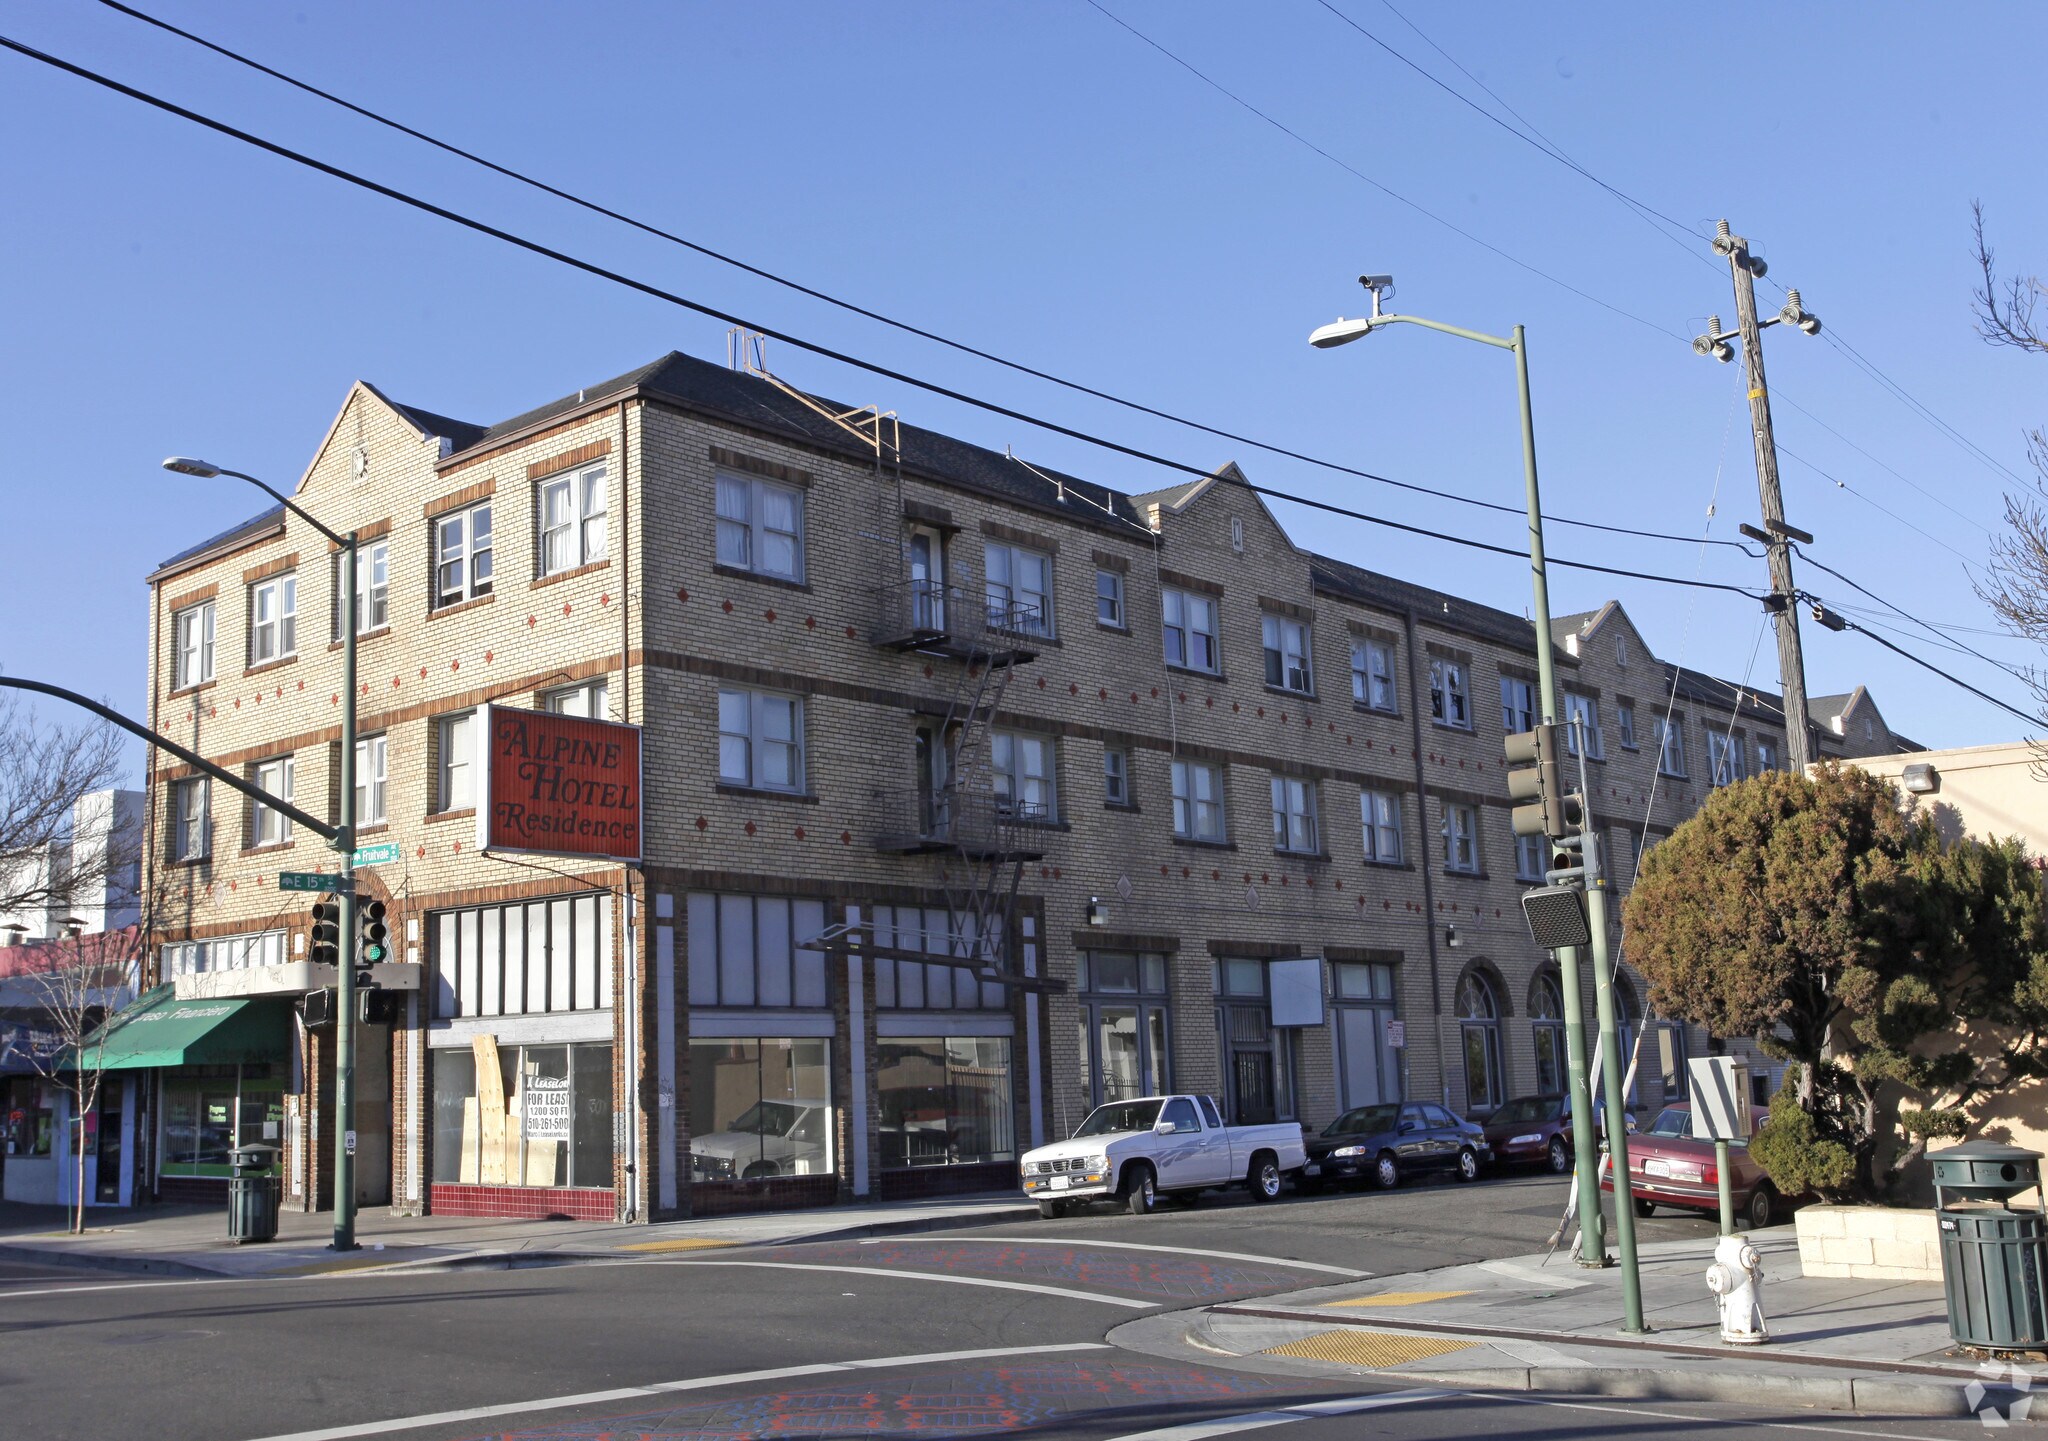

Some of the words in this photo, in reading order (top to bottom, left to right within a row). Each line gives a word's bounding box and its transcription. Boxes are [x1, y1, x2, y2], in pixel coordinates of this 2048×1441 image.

[496, 718, 621, 769] ALPINE
[518, 761, 635, 810] HOTEL
[495, 802, 635, 839] Residence
[362, 848, 389, 862] Fruitvale
[294, 876, 301, 887] E
[169, 1004, 231, 1020] Financiero
[528, 1092, 543, 1106] FOR
[549, 1106, 559, 1117] SQ
[560, 1106, 568, 1116] FT
